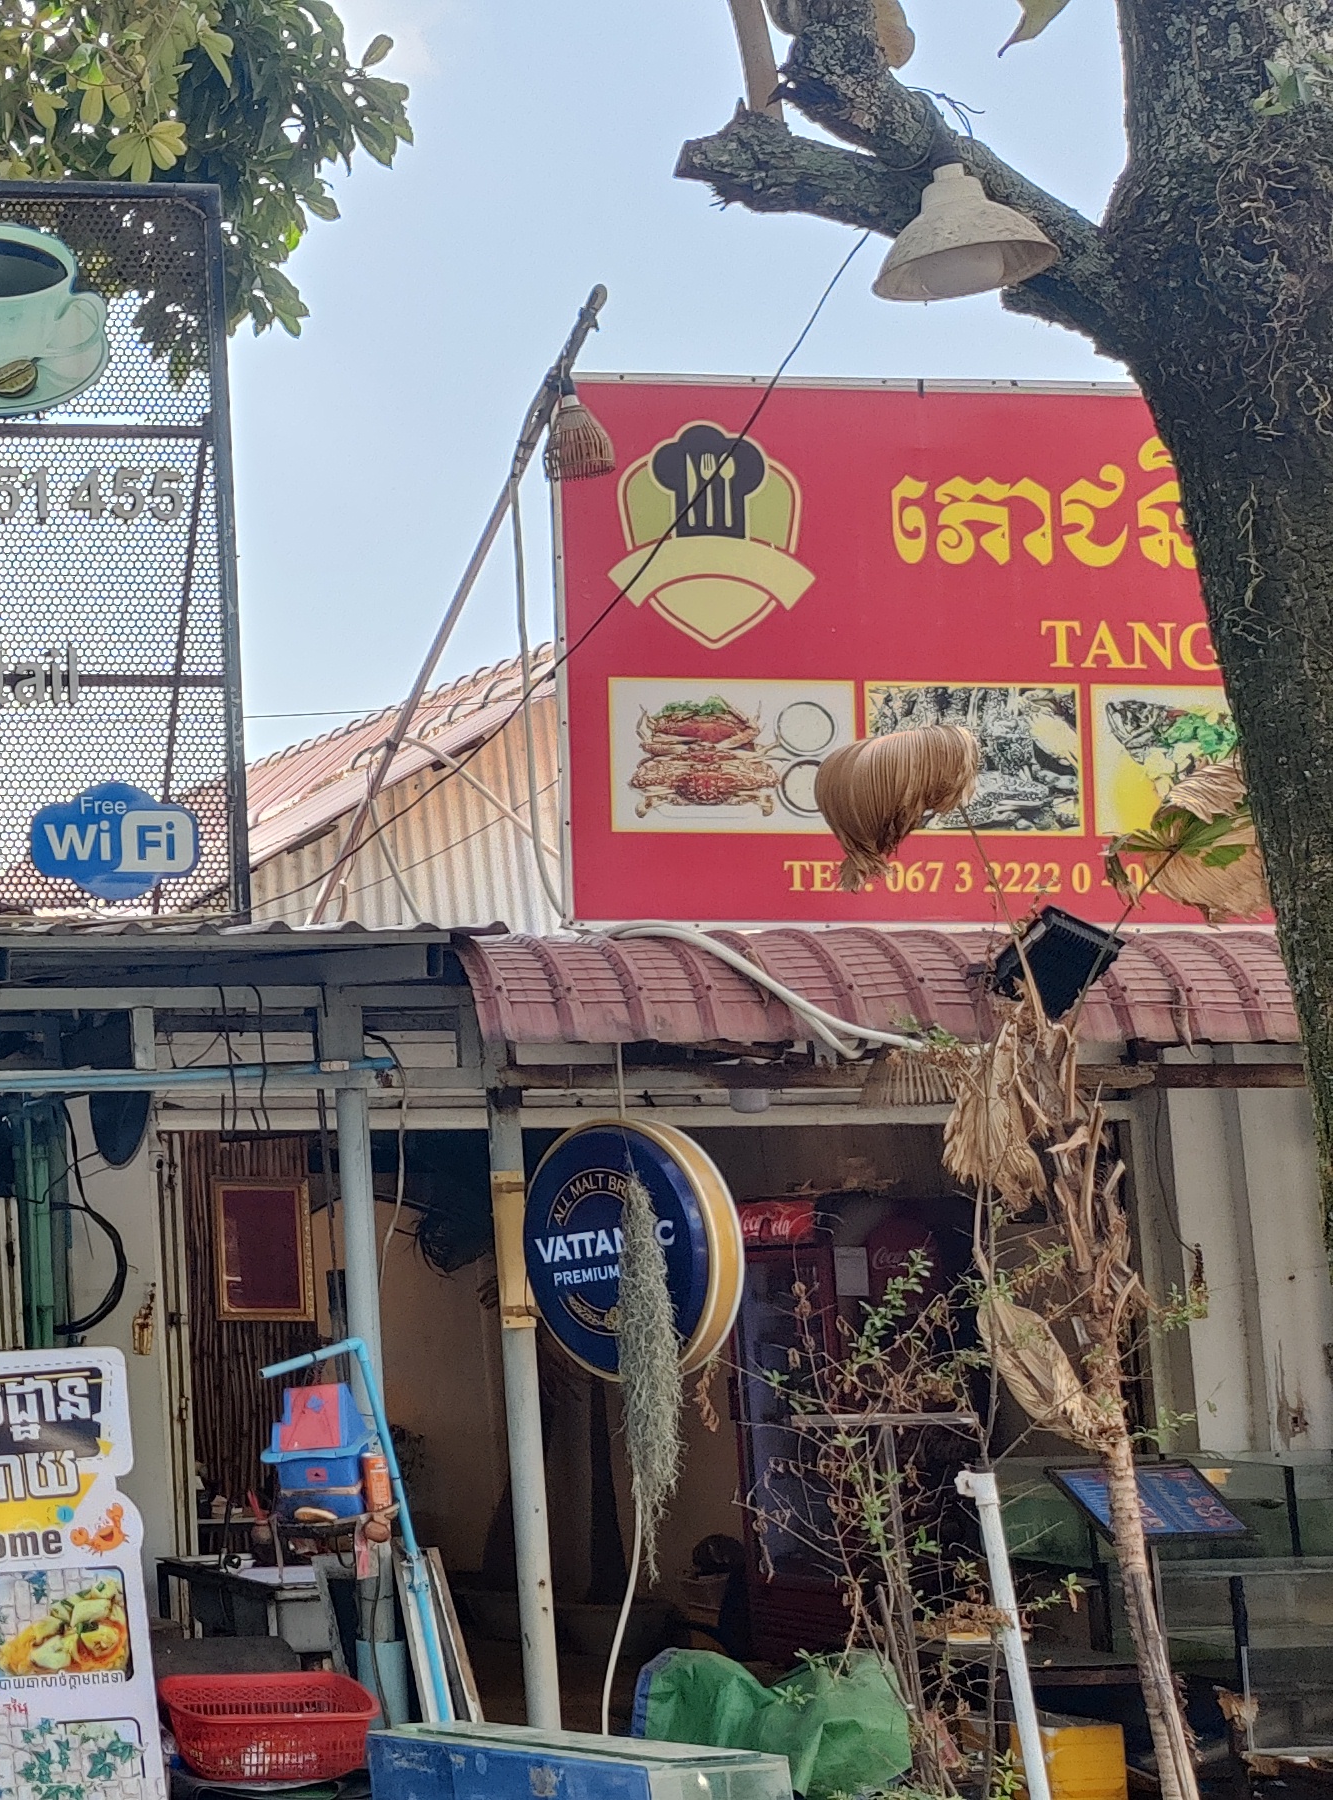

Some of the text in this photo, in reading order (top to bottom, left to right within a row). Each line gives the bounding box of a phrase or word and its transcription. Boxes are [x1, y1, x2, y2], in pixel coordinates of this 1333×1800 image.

[69, 469, 184, 521] 455
[80, 797, 128, 815] Free
[888, 861, 944, 893] 067
[954, 862, 973, 893] 3
[985, 862, 1062, 894] 2222
[1072, 862, 1091, 894] 0
[553, 1195, 573, 1226] ALL
[569, 1173, 605, 1200] MALT
[534, 1219, 675, 1264] VATTANC
[552, 1263, 621, 1287] PREMIUM
